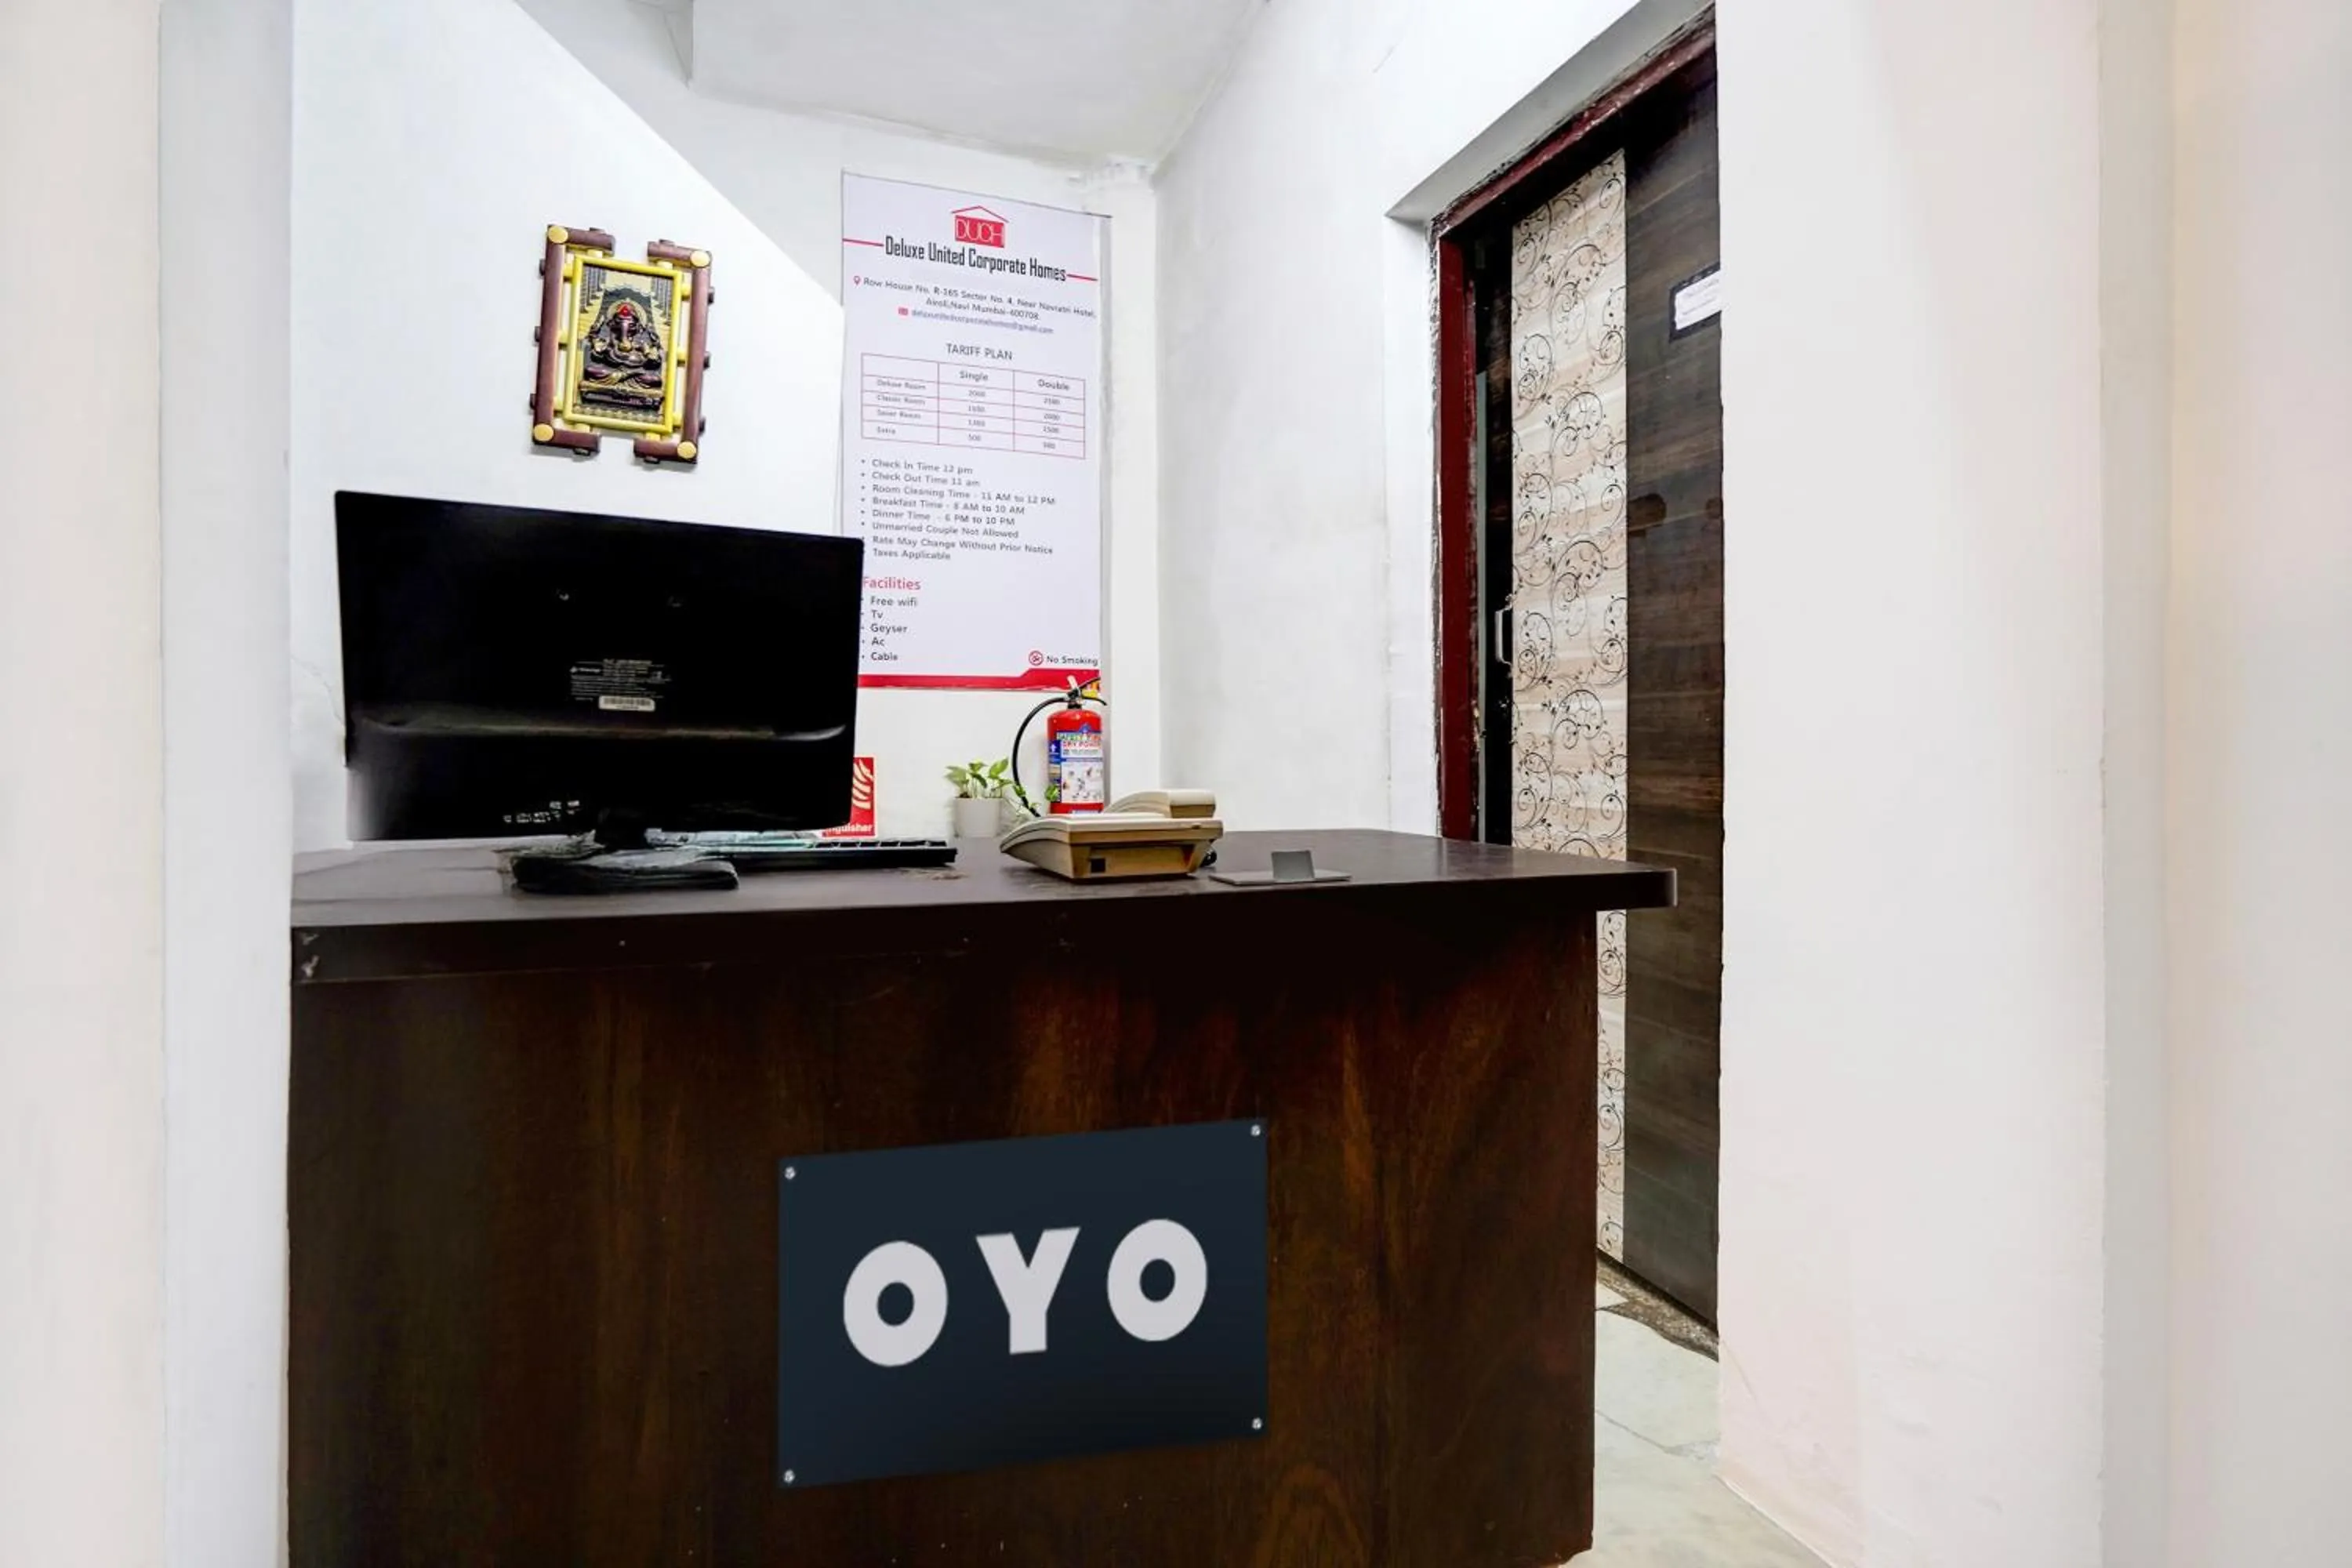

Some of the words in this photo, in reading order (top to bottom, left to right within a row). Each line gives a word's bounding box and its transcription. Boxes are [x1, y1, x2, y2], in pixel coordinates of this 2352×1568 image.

[885, 235, 925, 260] Deluxe
[928, 242, 965, 266] United
[968, 248, 1026, 275] Corporate
[1029, 257, 1067, 282] Homes
[863, 277, 883, 288] Row
[885, 280, 913, 291] House
[961, 290, 987, 300] Sector
[946, 343, 981, 357] TARIFF
[985, 347, 1013, 361] PLAN
[960, 371, 989, 383] Single
[1037, 379, 1070, 391] Double
[872, 459, 901, 469] Check
[904, 460, 913, 470] In
[917, 462, 941, 471] Time
[957, 466, 974, 475] pm
[872, 471, 901, 481] Check
[904, 474, 922, 482] Out
[926, 475, 948, 484] Time
[873, 485, 901, 493] Room
[948, 488, 971, 498] Time
[981, 492, 992, 500] 11
[1027, 495, 1037, 504] 12
[1040, 496, 1056, 505] PM
[873, 496, 916, 507] Breakfast
[920, 499, 943, 509] Time
[995, 505, 1006, 514] 10
[1009, 506, 1025, 515] AM
[872, 509, 904, 518] Dinner
[908, 511, 931, 520] Time
[954, 514, 970, 523] PM
[1000, 517, 1015, 526] PM
[873, 521, 923, 532] Unmarried
[926, 524, 958, 535] Couple
[962, 527, 979, 535] Not
[982, 528, 1019, 539] Allowed
[873, 535, 894, 544] Rate
[897, 537, 917, 548] May
[920, 539, 956, 550] Change
[959, 540, 996, 551] Without
[1000, 543, 1022, 552] Prior
[1025, 544, 1054, 554] Notice
[873, 548, 898, 557] Taxes
[901, 550, 951, 560] Applicable
[863, 576, 921, 590] Facilities
[870, 595, 894, 606] Free
[898, 597, 918, 607] wifi
[871, 609, 884, 619] Tv
[870, 623, 908, 635] Geyser
[871, 637, 885, 646] Ac
[870, 652, 898, 661] Cable
[1047, 655, 1059, 664] No
[1062, 655, 1098, 667] Smoking
[844, 1218, 1208, 1367] OYO
